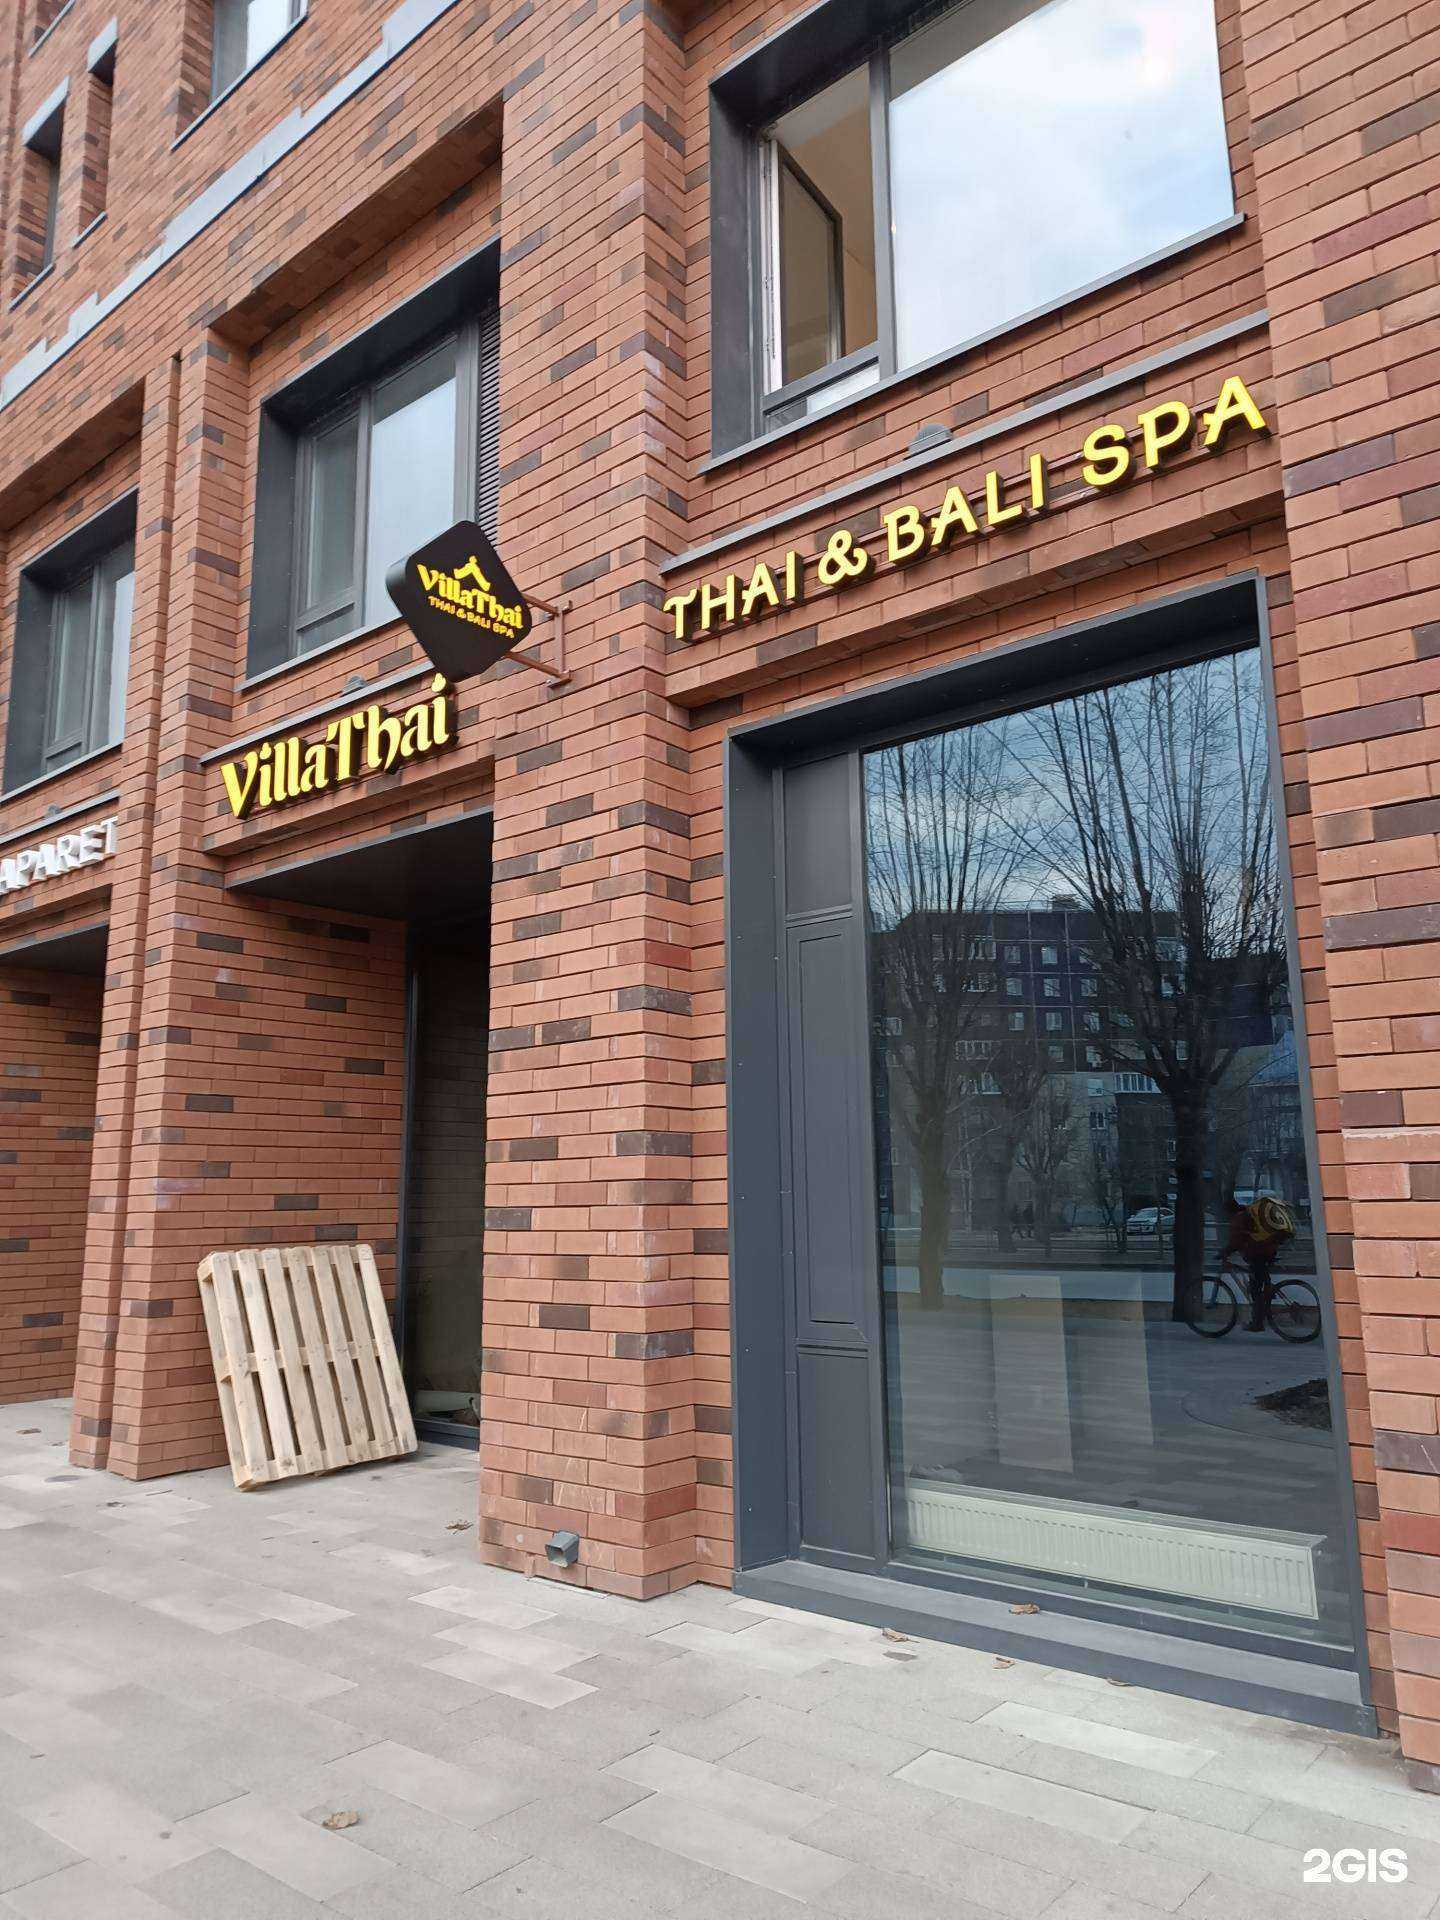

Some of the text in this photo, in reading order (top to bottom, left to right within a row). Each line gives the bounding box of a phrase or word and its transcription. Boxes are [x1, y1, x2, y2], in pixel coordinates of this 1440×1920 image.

[662, 374, 1267, 641] THAI & BALI SPA
[428, 595, 456, 615] THAI
[466, 611, 491, 629] BALI
[492, 622, 515, 639] SPA
